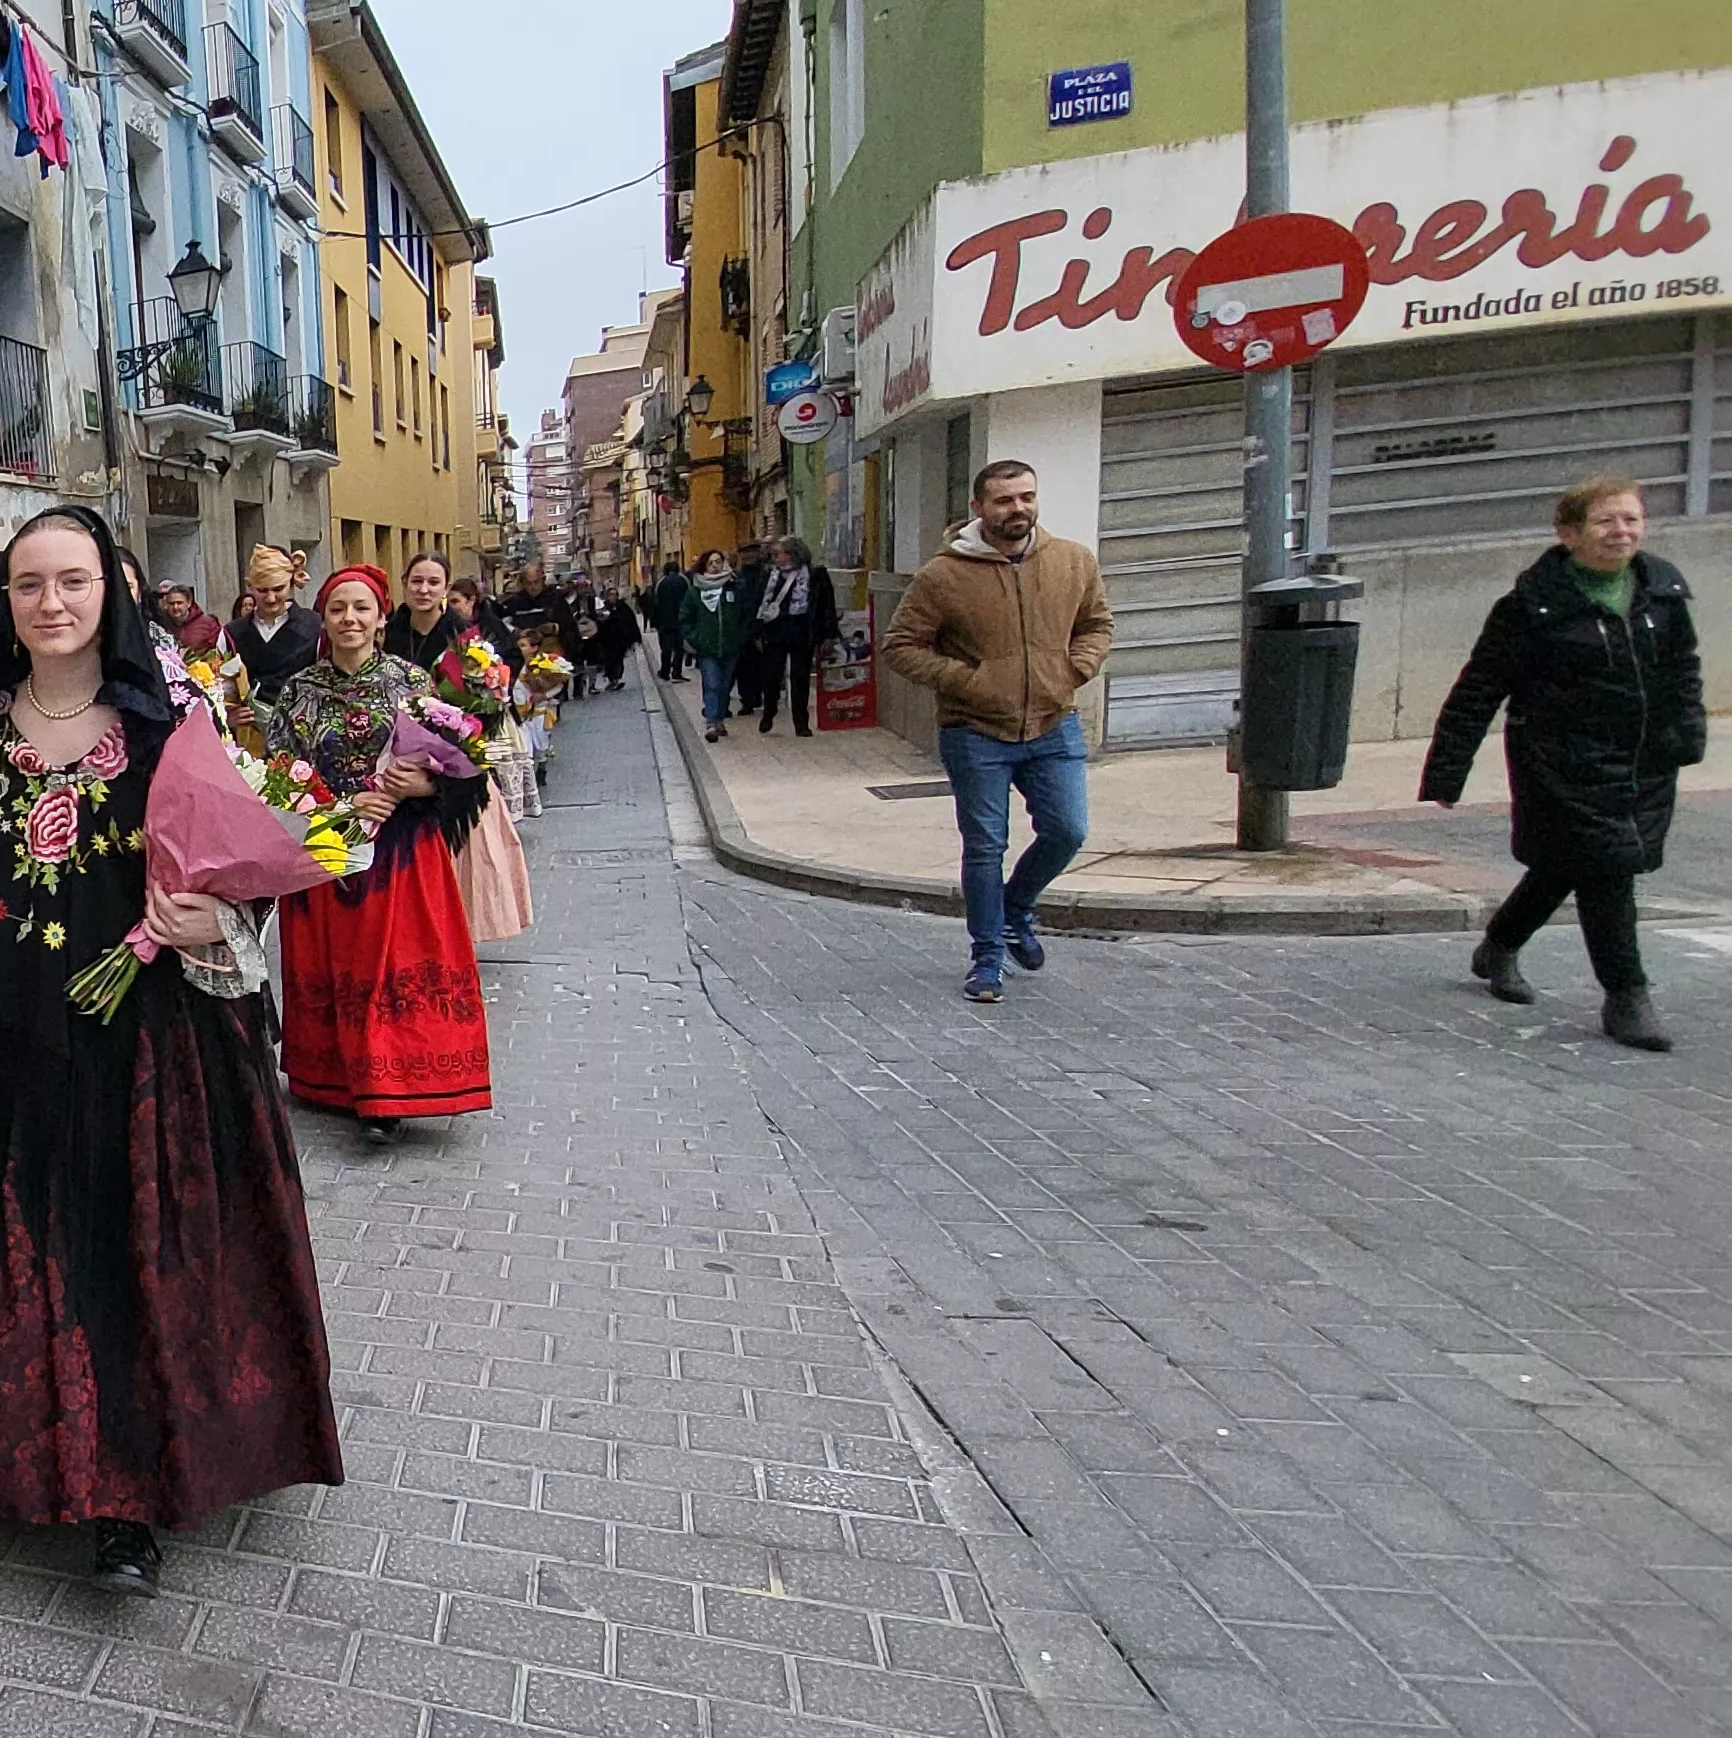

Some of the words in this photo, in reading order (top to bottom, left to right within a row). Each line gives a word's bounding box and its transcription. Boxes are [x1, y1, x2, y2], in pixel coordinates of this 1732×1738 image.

[1064, 72, 1118, 89] PLAZA
[1050, 90, 1130, 121] JUSTICIA
[947, 135, 1711, 336] Tinrería
[1401, 287, 1543, 331] Fundada
[1550, 281, 1582, 310] el
[1587, 279, 1647, 306] año
